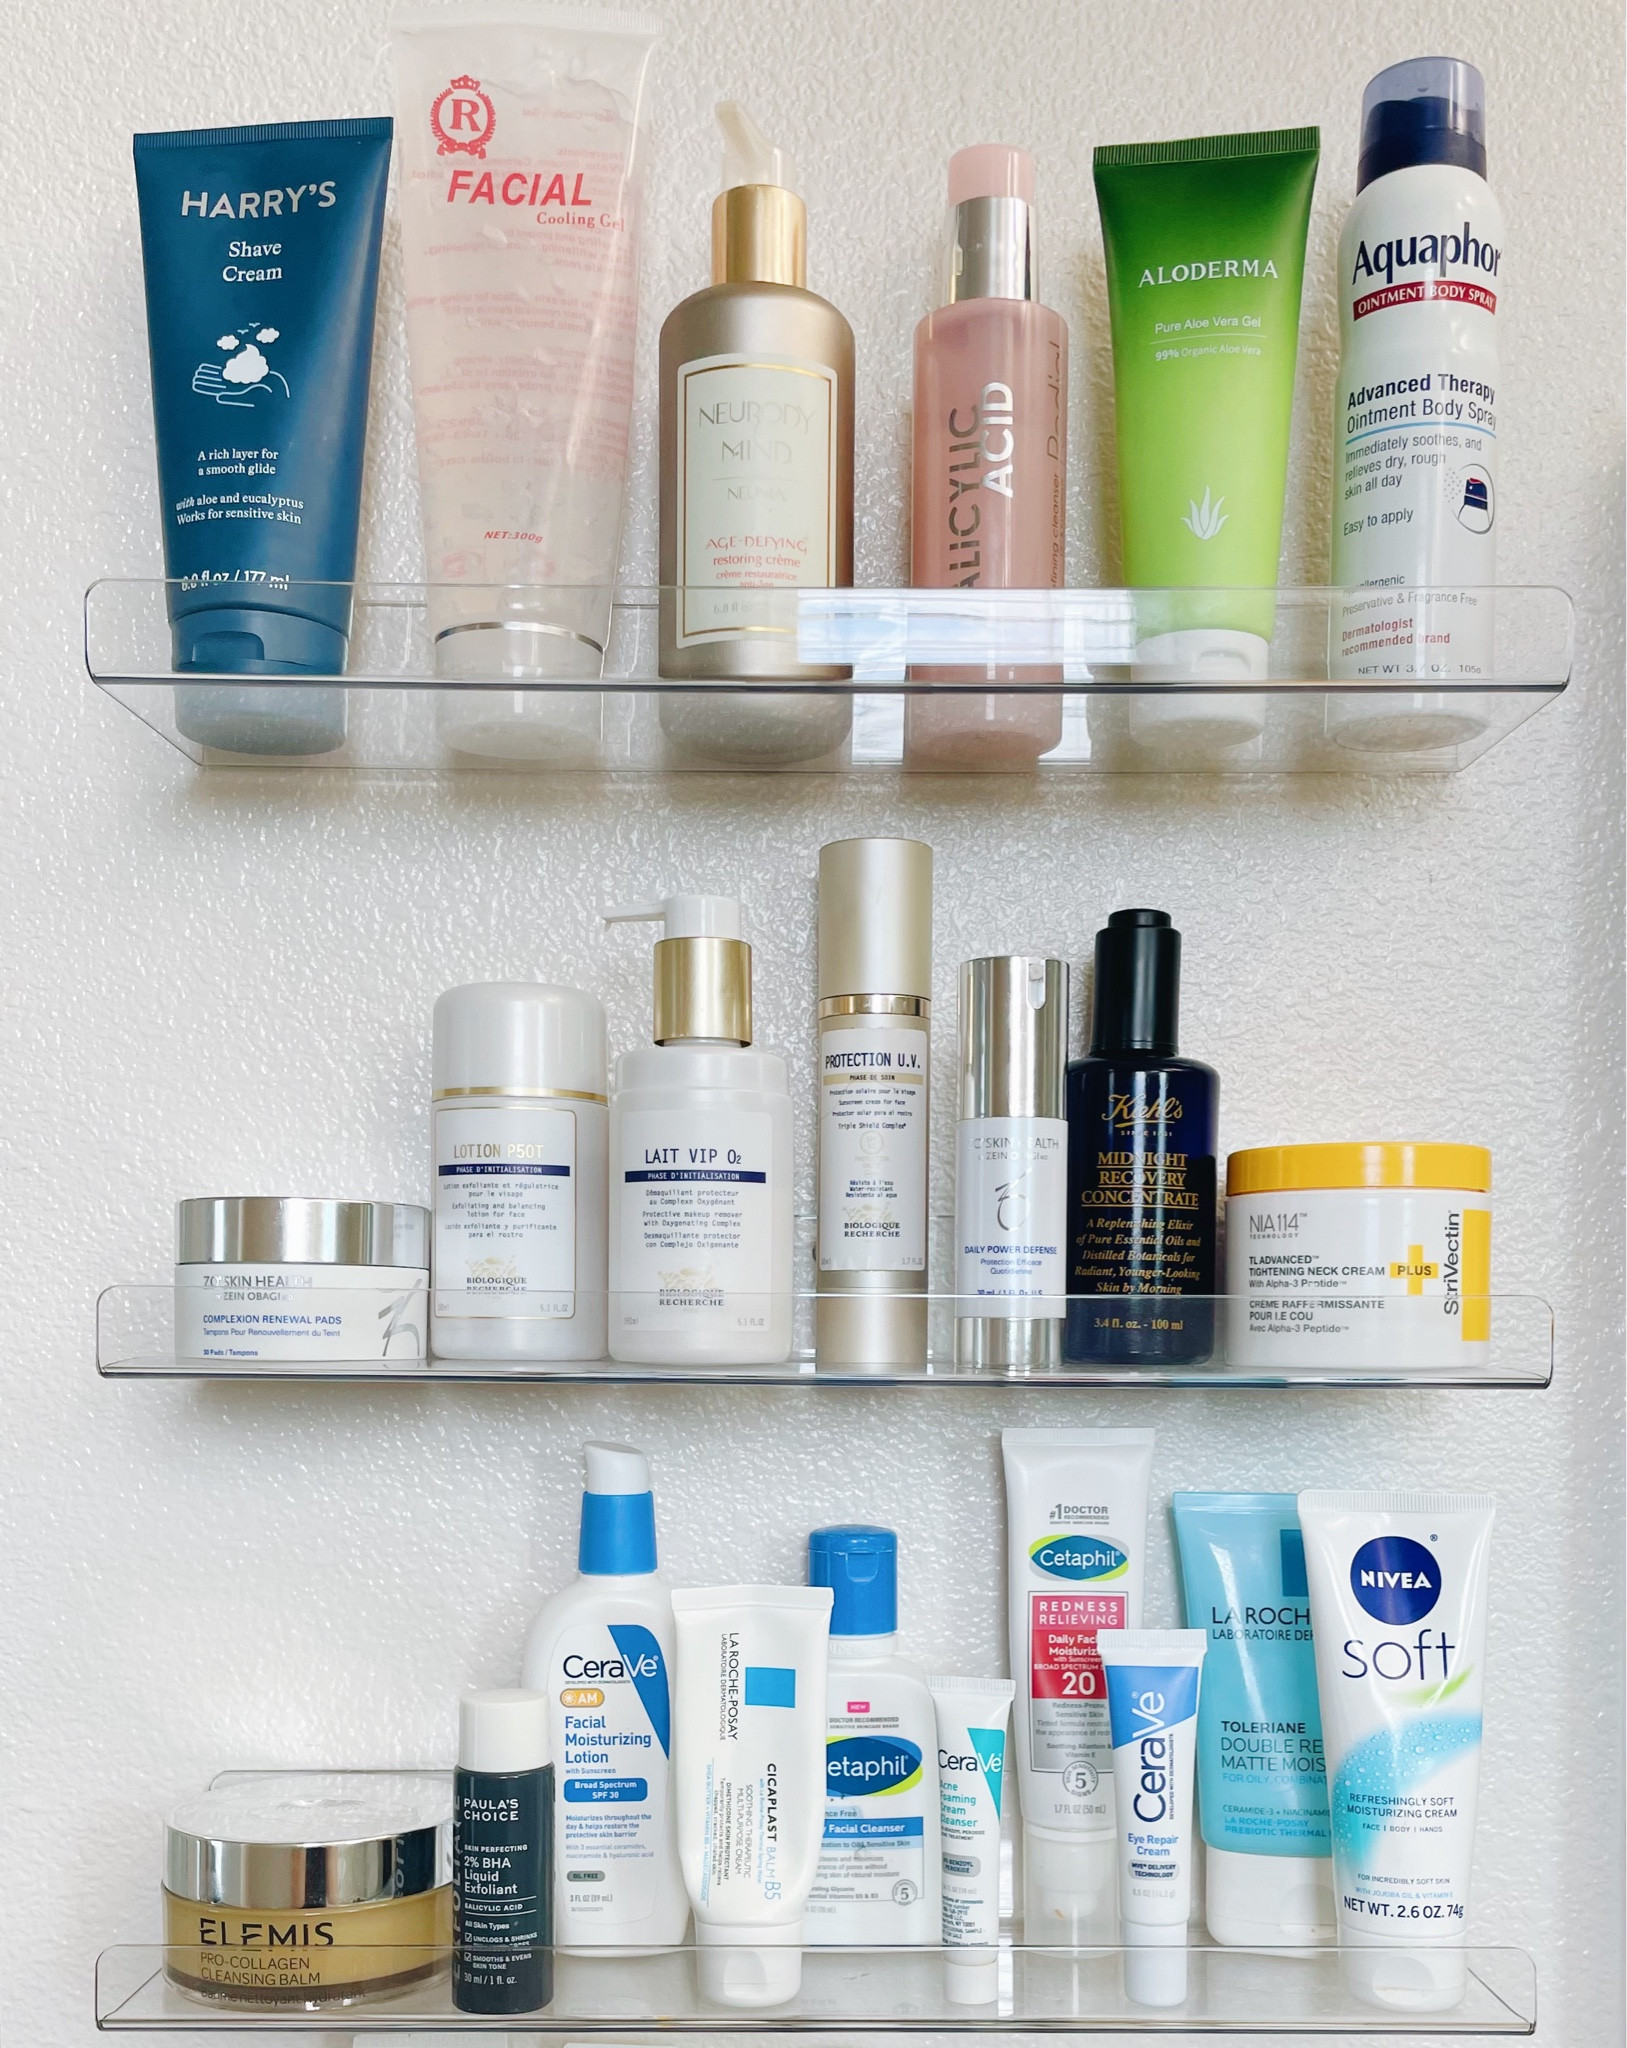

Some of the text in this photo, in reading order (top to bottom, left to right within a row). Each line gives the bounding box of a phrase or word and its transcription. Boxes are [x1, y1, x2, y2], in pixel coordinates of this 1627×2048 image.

[449, 99, 481, 132] R
[447, 170, 592, 206] FACIAL
[180, 180, 336, 219] HARRY'S
[536, 212, 625, 232] Cooling Gel
[228, 242, 282, 258] Shave
[1352, 221, 1503, 286] Aquaphor
[222, 266, 282, 282] Cream
[1138, 260, 1279, 288] ALODERMA
[1358, 285, 1494, 314] OINTMENT BODY SPRAY
[1155, 316, 1261, 334] Pure Aloe Vera Gel
[1348, 374, 1495, 411] Advanced Therapy
[1347, 399, 1496, 434] Ointment Body Spray
[981, 382, 1014, 498] ACID
[198, 448, 279, 461] A rich layer for
[1346, 434, 1482, 464] Immediately soothes, and
[206, 465, 245, 475] smooth
[248, 465, 276, 476] glide
[1345, 452, 1446, 482] relieves dry, rough
[1345, 474, 1403, 501] skin all day
[176, 493, 304, 511] with aloe and eucalyptus
[177, 508, 301, 525] Works for sensitive skin
[1344, 508, 1414, 536] Easy to apply
[484, 530, 543, 543] NET:300g
[713, 554, 800, 567] restoring crème
[1342, 618, 1414, 641] Dermatologist
[1342, 634, 1414, 657] recommended
[826, 1052, 921, 1069] PROTECTION U.V.
[1102, 1094, 1183, 1121] Kiehl's
[454, 1144, 500, 1159] LOTION
[645, 1148, 679, 1164] LAIT
[689, 1148, 718, 1164] VIP
[1098, 1152, 1188, 1167] MIDNIGHT
[671, 1172, 740, 1180] D'INITIALISATION
[1099, 1172, 1186, 1186] RECOVERY
[1081, 1191, 1199, 1206] CONCENTRATE
[844, 1222, 900, 1230] BIOLOGIQUE
[965, 1246, 985, 1254] DAILY
[988, 1246, 1021, 1254] POWER
[1083, 1250, 1125, 1261] Distilled
[1397, 1266, 1431, 1275] PLUS
[1444, 1213, 1460, 1315] StriVectin
[1249, 1267, 1385, 1276] TIGHTENING NECK CREAM
[467, 1277, 527, 1285] BIOLOGIQUE
[1096, 1283, 1120, 1293] Skin
[203, 1315, 342, 1325] COMPLEXION RENEWAL PADS
[1094, 1318, 1169, 1329] 3.4 100
[1064, 1506, 1109, 1514] DOCTOR
[1360, 1570, 1432, 1589] NIVEA
[1039, 1601, 1118, 1612] REDNESS
[1039, 1614, 1118, 1625] RELIEVING
[1212, 1607, 1241, 1624] LA
[1048, 1634, 1075, 1646] Daily
[1212, 1629, 1291, 1640] LABORATOIRE
[727, 1632, 739, 1741] LA ROCHE-POSAY
[1061, 1672, 1096, 1695] 20
[578, 1693, 598, 1704] AM
[565, 1716, 605, 1728] Facial
[1221, 1721, 1306, 1734] TOLERIANE
[565, 1733, 651, 1747] Moisturizing
[1221, 1737, 1293, 1753] DOUBLE
[565, 1751, 608, 1763] Lotion
[1221, 1755, 1276, 1772] MATTE
[574, 1781, 637, 1790] Broad Spectrum
[592, 1791, 619, 1799] SPF 30
[1350, 1793, 1454, 1806] REFRESHINGLY SOFT
[464, 1799, 519, 1809] PAULA'S
[464, 1811, 519, 1821] CHOICE
[1347, 1806, 1458, 1818] MOISTURIZING CREAM
[764, 1763, 781, 1900] CICAPLAST BALM B5
[829, 1824, 905, 1834] Facial Cleanser
[1128, 1833, 1178, 1846] Eye Repair
[481, 1844, 527, 1852] PERFECTING
[1137, 1847, 1170, 1856] Cream
[464, 1856, 511, 1868] 2% BHA
[464, 1870, 499, 1882] Liquid
[464, 1883, 518, 1894] Exfoliant
[464, 1903, 501, 1911] SALICYLIC
[1344, 1896, 1464, 1919] NET WT. 2.6 OZ. 74g
[200, 1918, 334, 1951] ELEMIS
[201, 1952, 310, 1970] PRO-COLLAGEN
[201, 1967, 320, 1985] CLEANSING BALM
